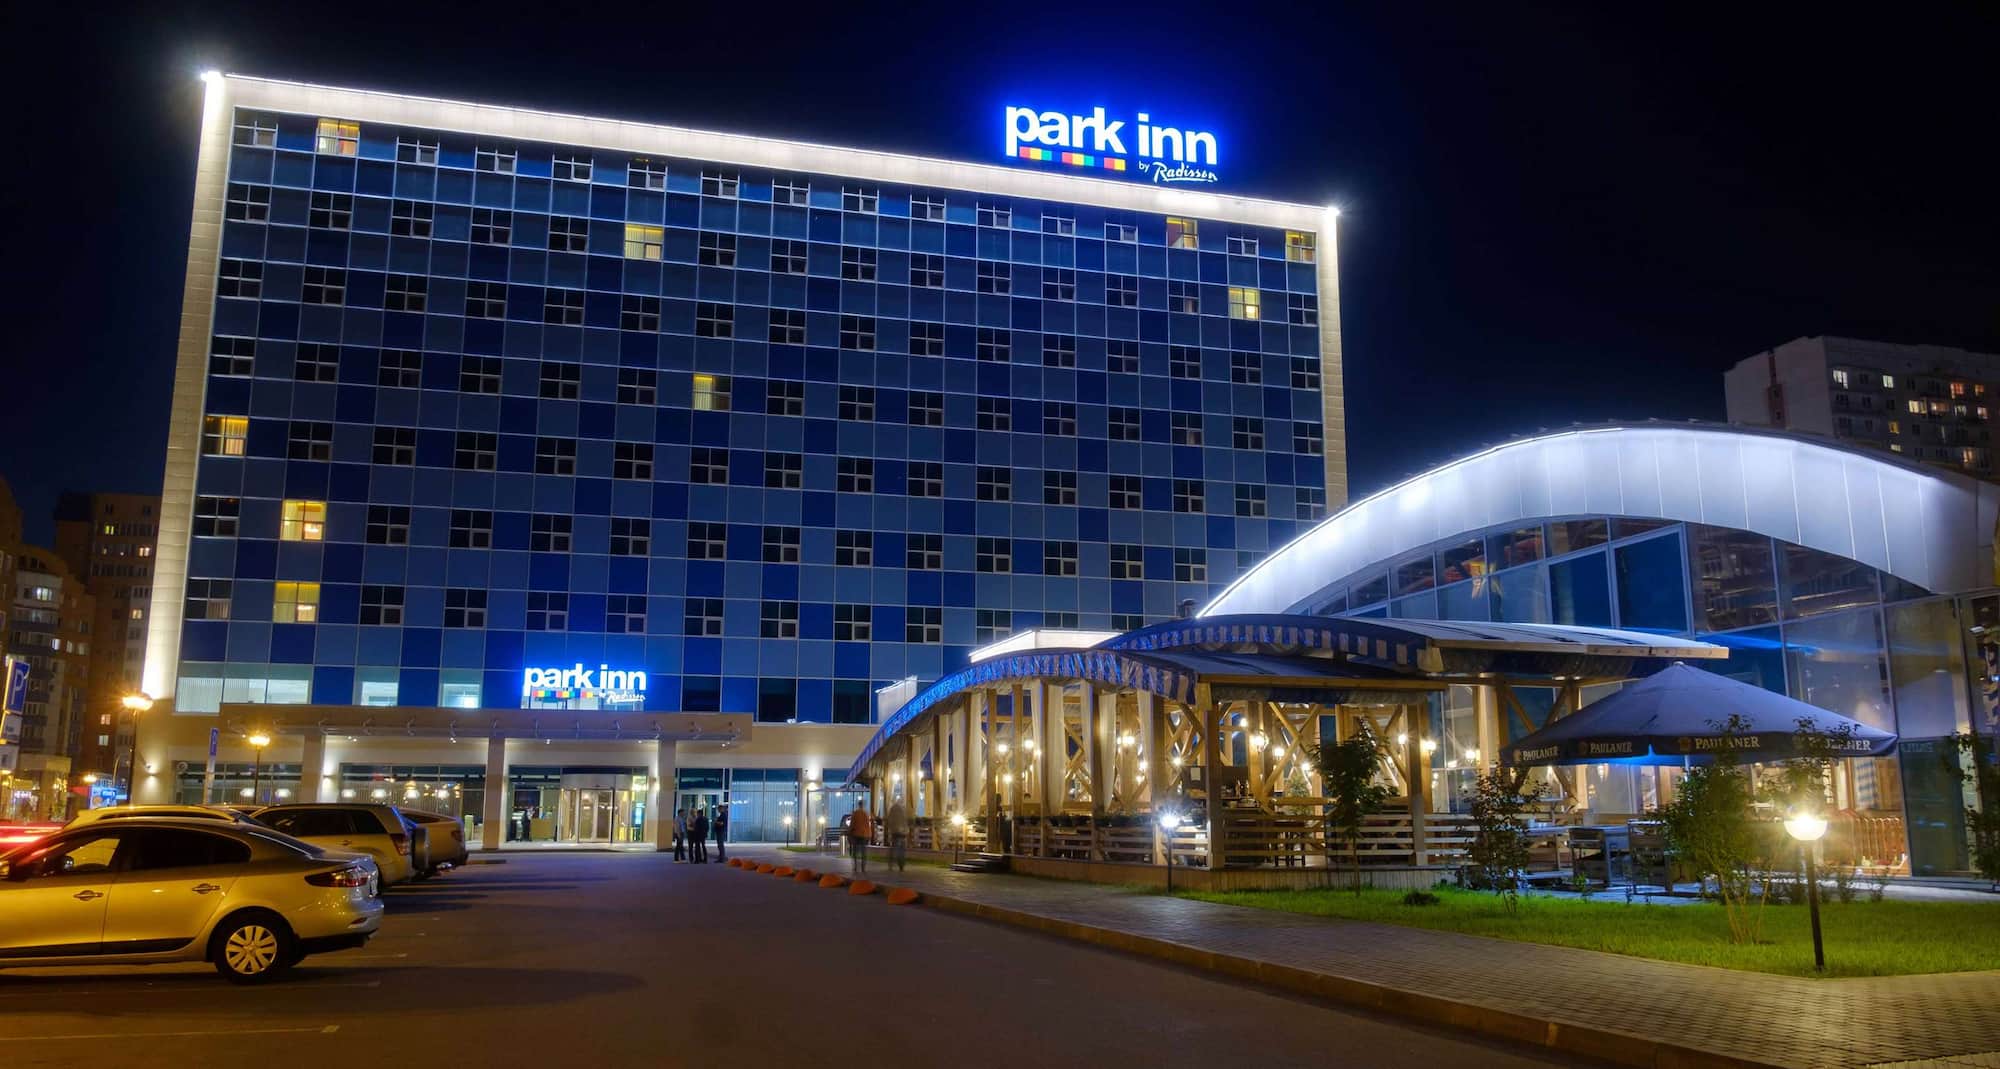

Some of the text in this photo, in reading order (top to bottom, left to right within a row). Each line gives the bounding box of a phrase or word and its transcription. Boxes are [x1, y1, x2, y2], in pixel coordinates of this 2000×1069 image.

[1006, 106, 1217, 165] park inn
[1138, 160, 1218, 183] by Radisson
[523, 663, 647, 696] park inn
[1590, 741, 1633, 753] PAULANER
